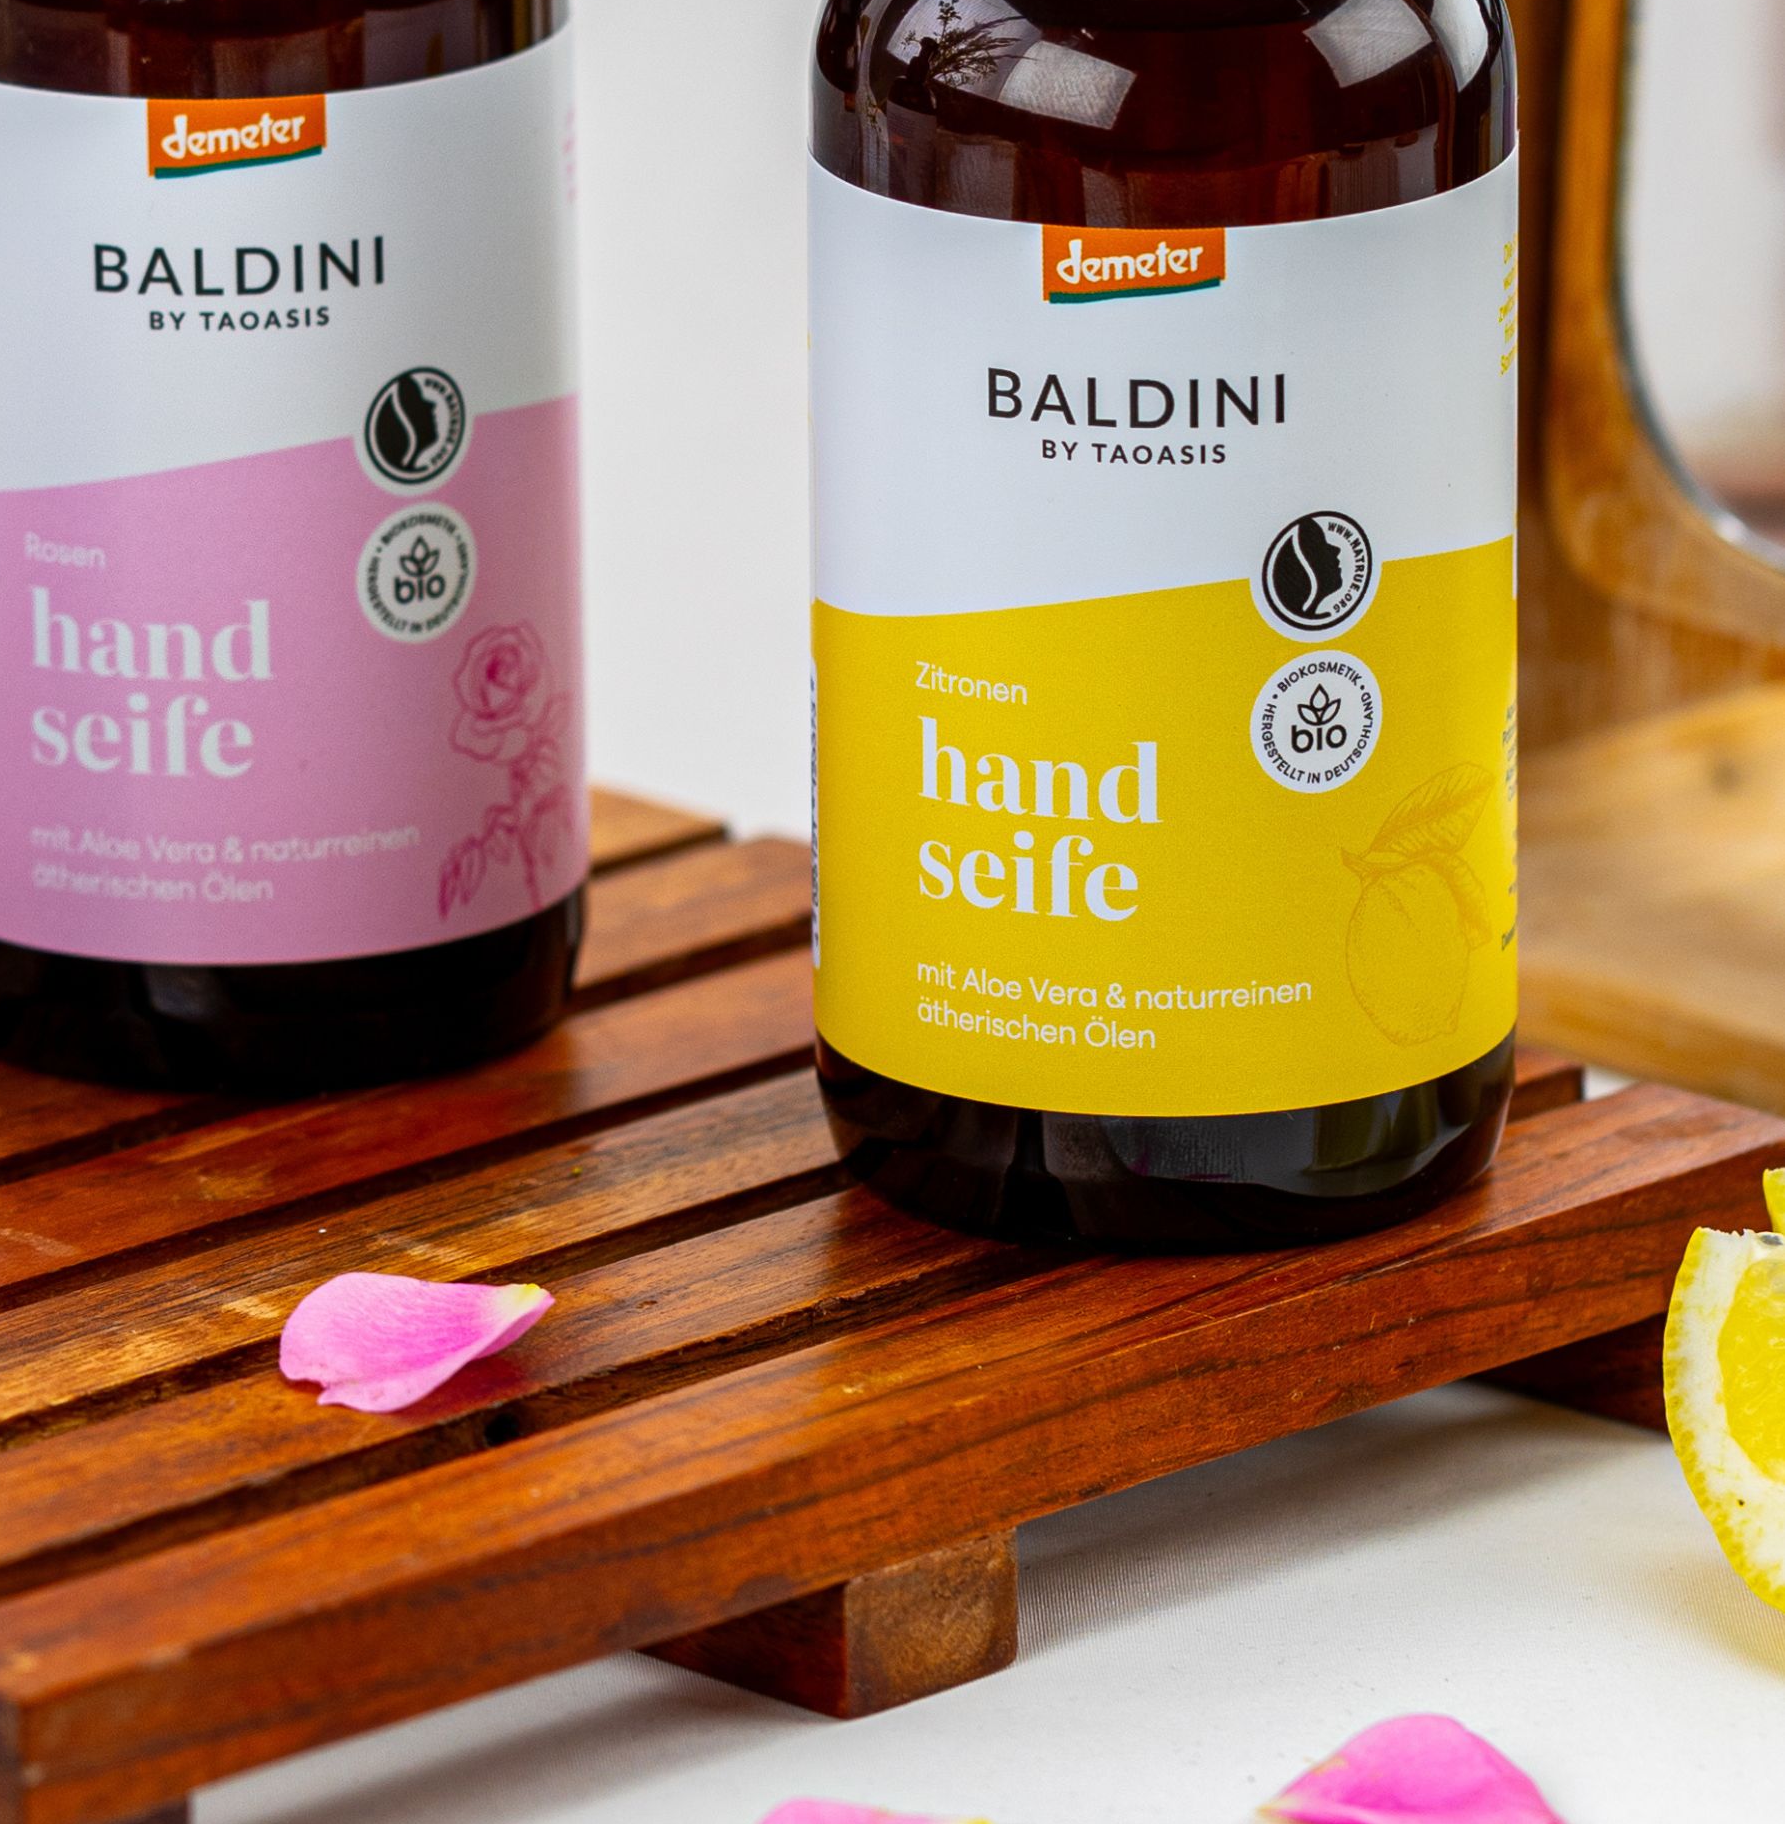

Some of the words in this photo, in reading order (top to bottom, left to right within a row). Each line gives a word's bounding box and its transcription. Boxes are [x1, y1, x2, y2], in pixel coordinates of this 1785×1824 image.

[161, 113, 306, 159] demeter
[94, 235, 384, 296] BALDINI
[1056, 239, 1203, 284] demeter
[149, 311, 185, 330] BY
[200, 307, 330, 331] TAOASIS
[988, 367, 1285, 428] BALDINI
[1042, 439, 1078, 460] BY
[1091, 442, 1226, 465] TAOASIS
[24, 530, 105, 568] Rosen
[1327, 521, 1365, 613] WWW.NATRUE.ORG
[394, 574, 446, 604] bio
[32, 586, 275, 682] hand
[915, 660, 1028, 705] Zitronen
[1277, 661, 1362, 692] BIOKOSMETIK
[32, 691, 254, 777] seife
[1261, 703, 1305, 782] HERGESTELLT
[1307, 772, 1321, 784] IN
[1324, 692, 1374, 782] DEUTSCHLAND
[1291, 724, 1347, 753] bio
[917, 715, 1163, 824] hand
[30, 826, 71, 851] mit
[79, 829, 140, 860] Aloe
[146, 834, 214, 863] Vera
[221, 835, 244, 863] &
[251, 825, 420, 862] naturreinen
[203, 867, 274, 902] Ölen
[918, 830, 1139, 922] seife
[917, 961, 956, 990] mit
[961, 968, 1022, 1000] Aloe
[1028, 976, 1097, 1008] Vera
[1105, 983, 1127, 1009] &
[1134, 980, 1312, 1010] naturreinen
[917, 995, 1076, 1046] ätherischen
[1084, 1015, 1156, 1049] Ölen
